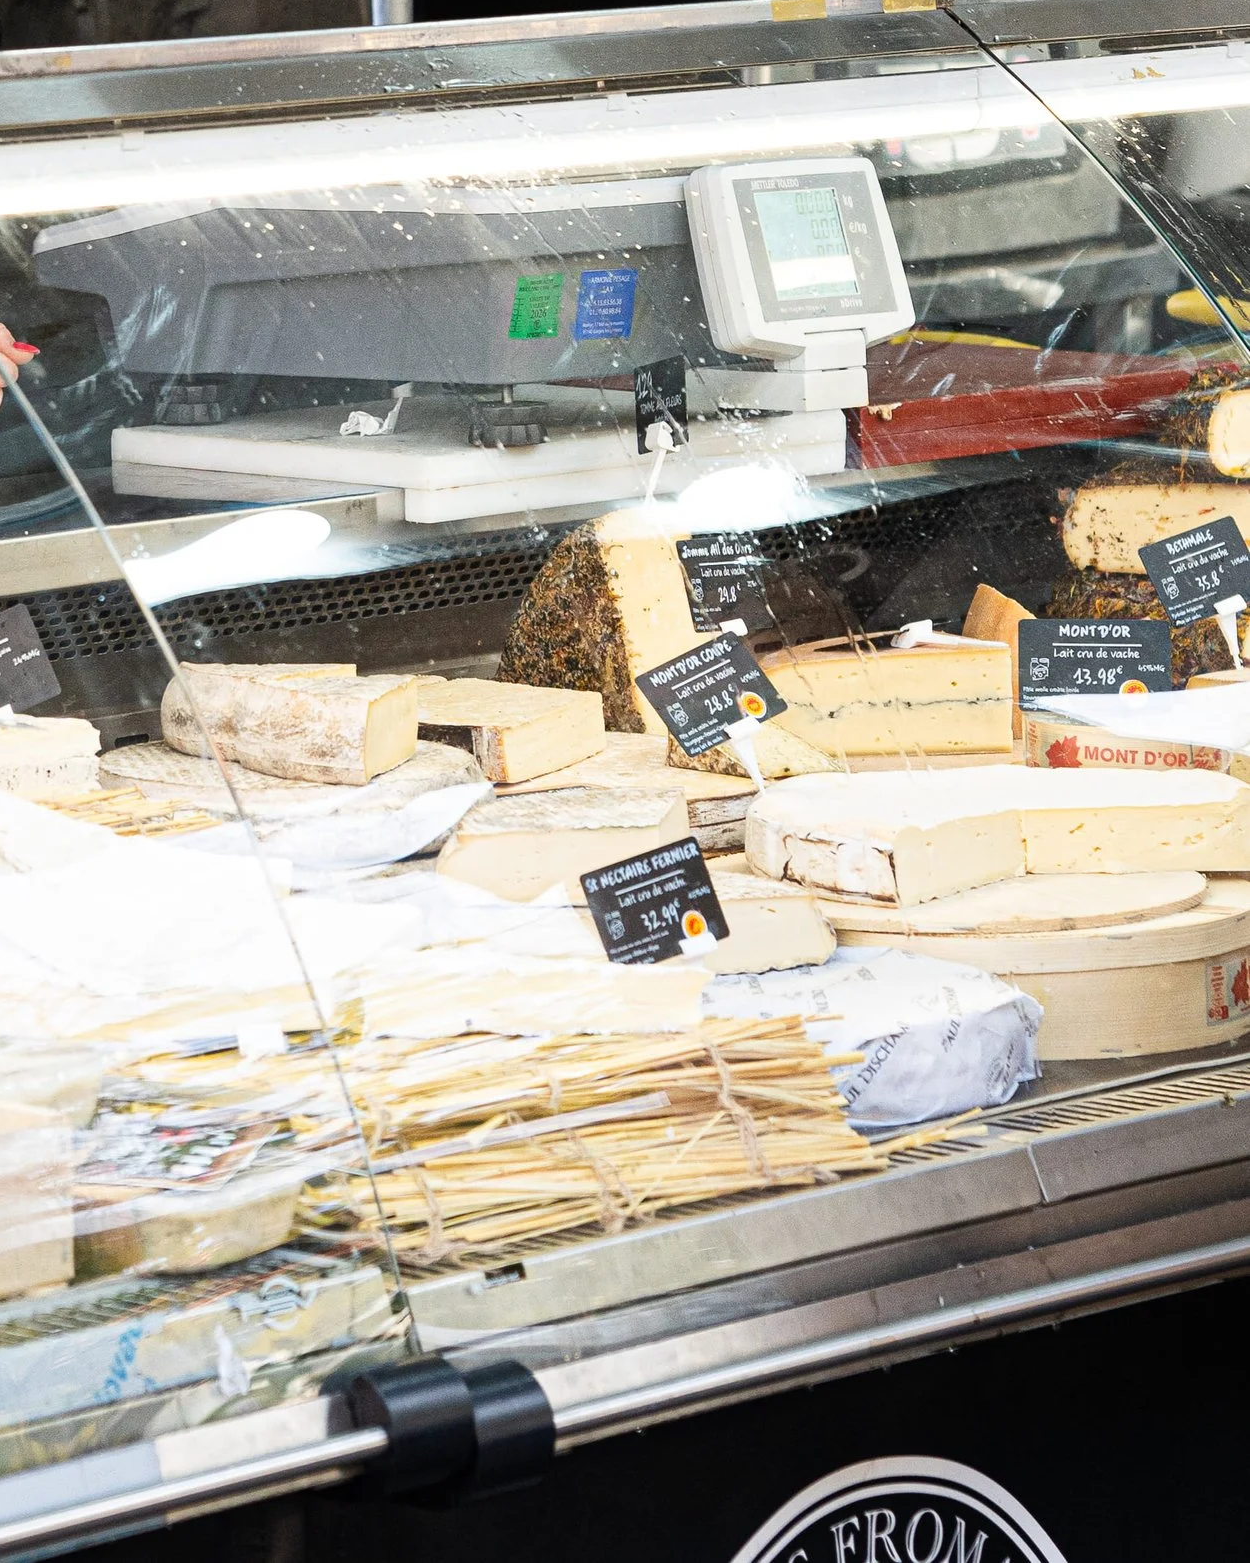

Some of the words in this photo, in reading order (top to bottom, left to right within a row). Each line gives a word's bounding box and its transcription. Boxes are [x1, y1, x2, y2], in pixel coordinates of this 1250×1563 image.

[1165, 528, 1215, 556] BETHMALE
[700, 567, 713, 578] Lait
[730, 565, 747, 576] vache
[1171, 563, 1188, 575] Lait
[1187, 560, 1200, 570] cru
[1208, 547, 1230, 562] vache
[1053, 647, 1075, 659] Lait
[1076, 650, 1094, 659] cru
[1095, 647, 1108, 659] de
[1110, 648, 1141, 659] vache
[675, 685, 694, 700] Lait
[692, 680, 707, 693] cru
[705, 674, 717, 687] de
[714, 665, 737, 681] vache
[1083, 746, 1139, 765] MONT
[1144, 750, 1189, 768] D'OR
[599, 858, 652, 889] NECTAIRE
[650, 841, 700, 870] FERMIER
[618, 893, 637, 908] Lait
[637, 890, 652, 902] cru
[651, 883, 664, 897] de
